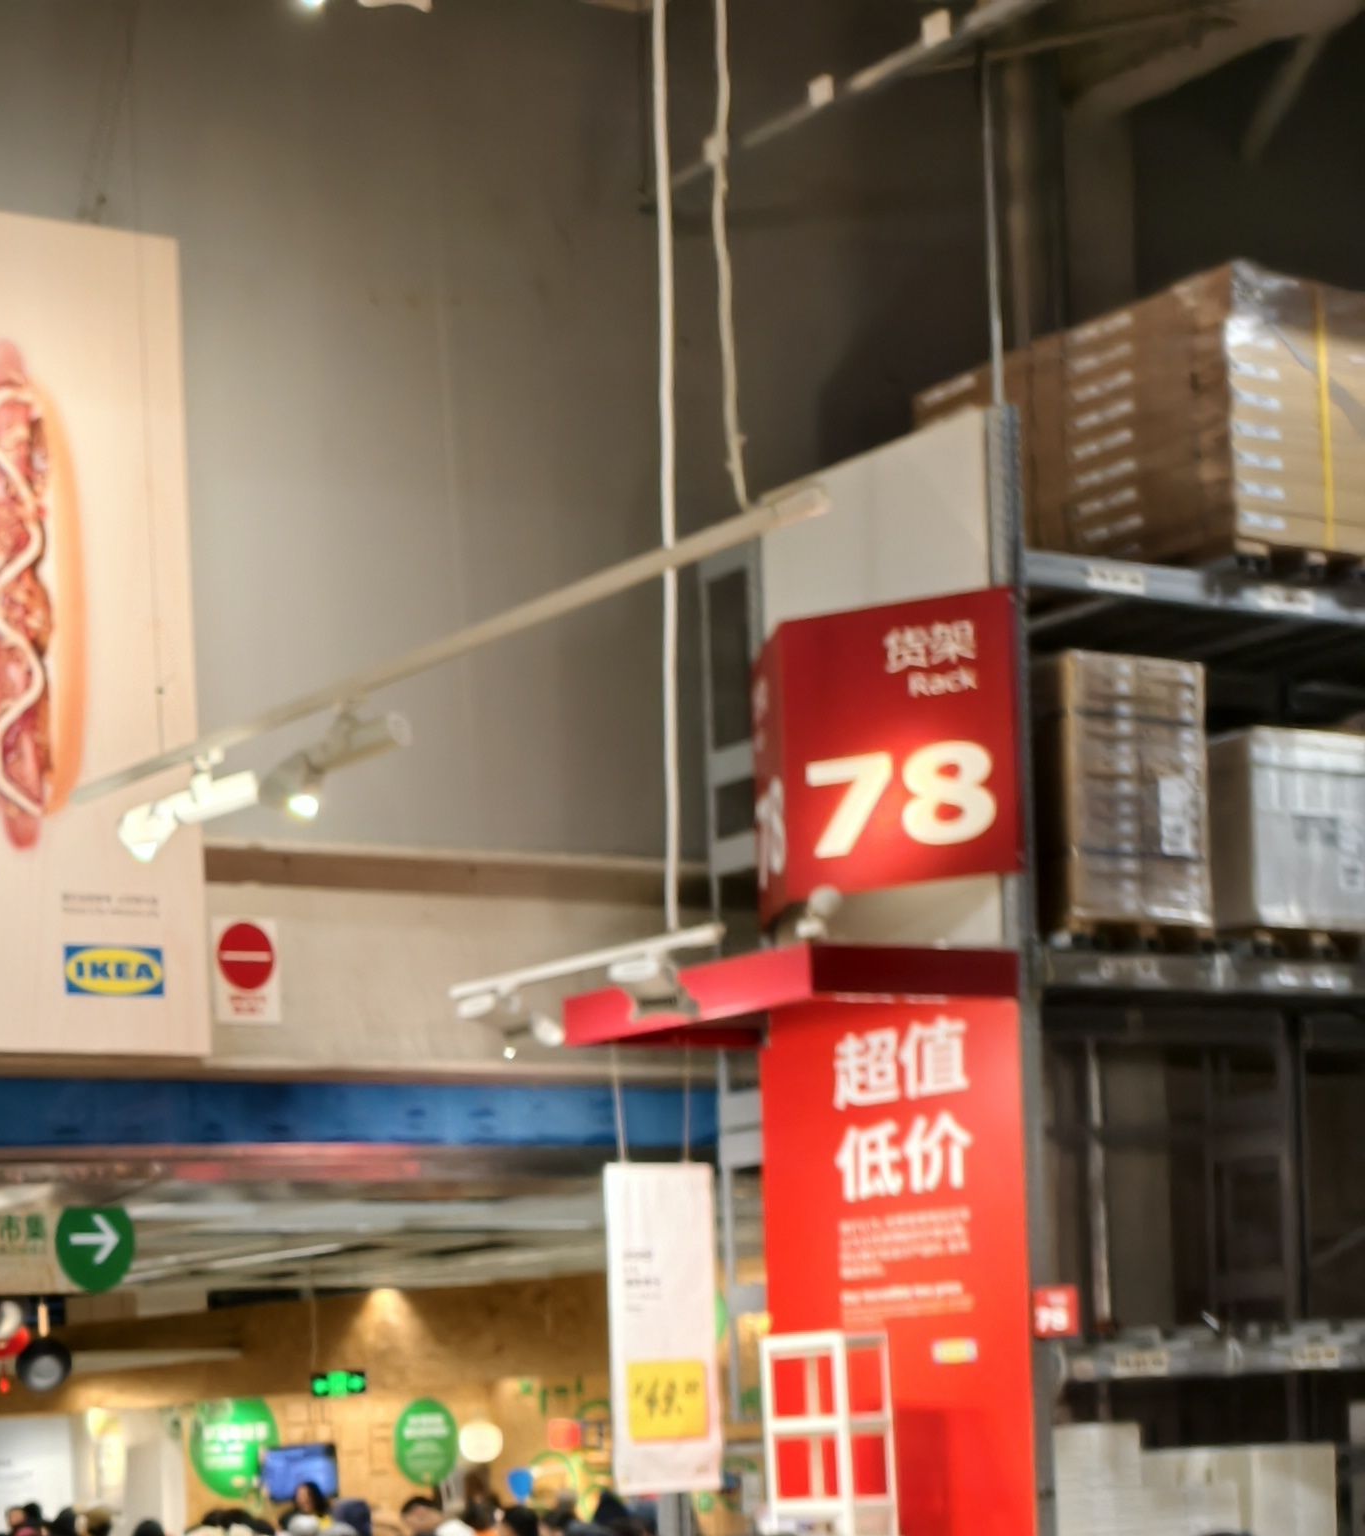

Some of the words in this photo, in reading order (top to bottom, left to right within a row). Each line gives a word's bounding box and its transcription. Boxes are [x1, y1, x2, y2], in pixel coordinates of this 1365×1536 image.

[883, 620, 976, 673] 货架
[908, 666, 978, 697] Rack
[805, 740, 997, 860] 78
[75, 961, 155, 980] IKEA
[833, 1016, 970, 1110] 超值
[835, 1111, 972, 1202] 低价
